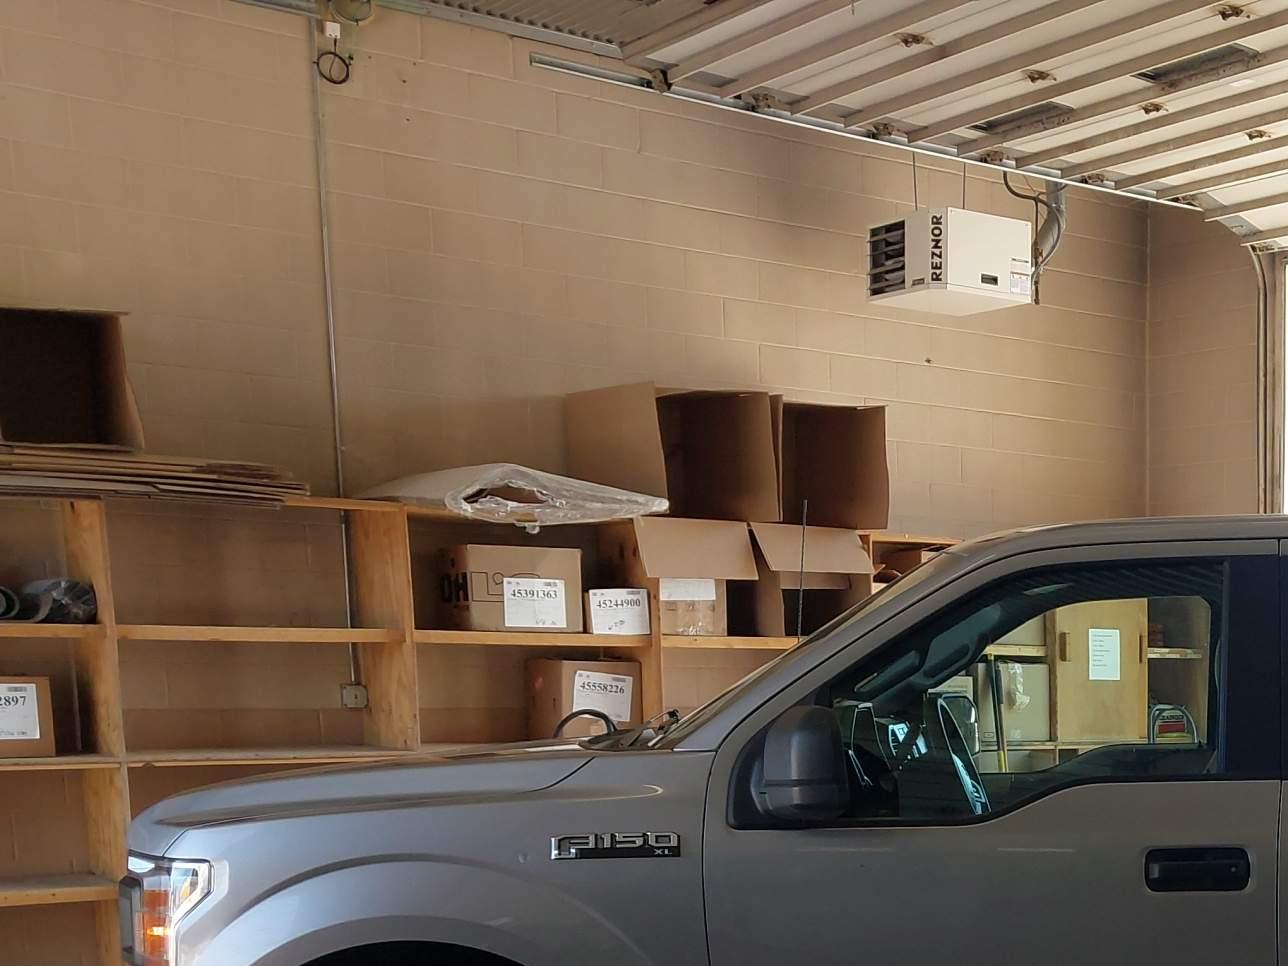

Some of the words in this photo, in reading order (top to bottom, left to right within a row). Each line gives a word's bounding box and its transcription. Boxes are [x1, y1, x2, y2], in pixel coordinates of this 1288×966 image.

[931, 215, 943, 282] REZNOR
[510, 588, 558, 599] 45391363
[596, 598, 641, 609] 45244900
[579, 680, 625, 694] 45558226
